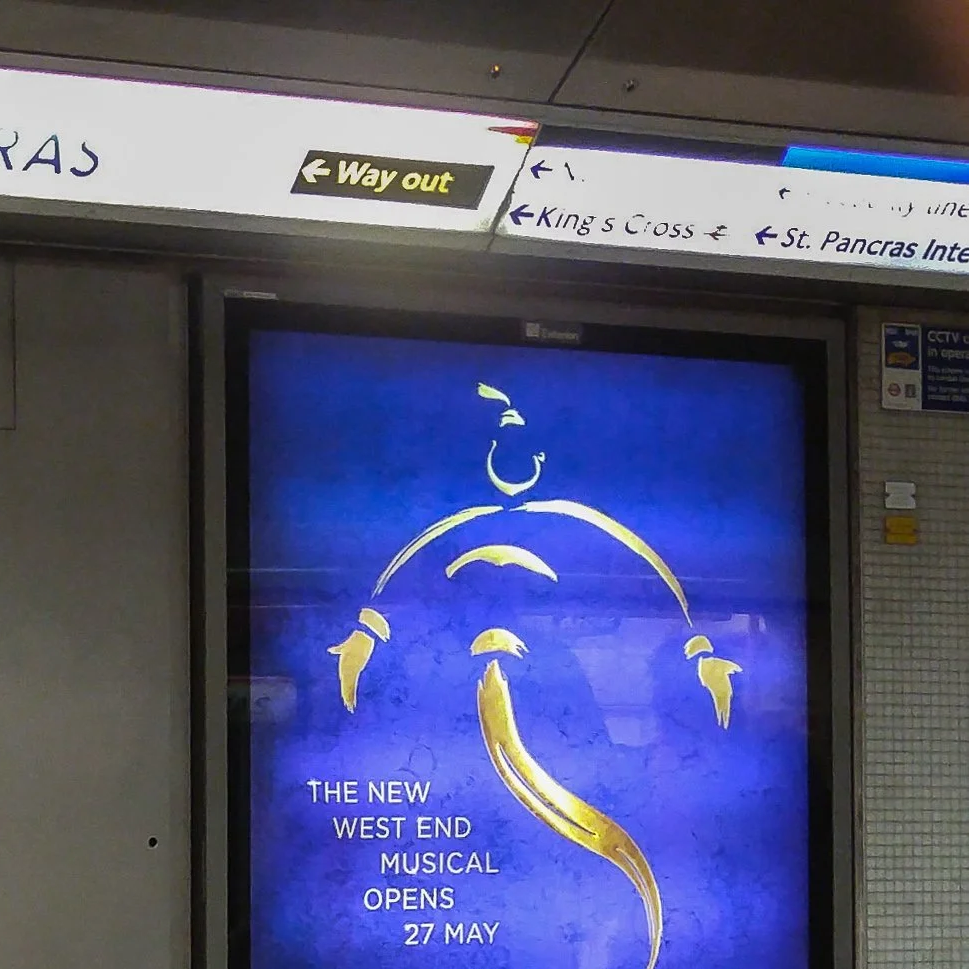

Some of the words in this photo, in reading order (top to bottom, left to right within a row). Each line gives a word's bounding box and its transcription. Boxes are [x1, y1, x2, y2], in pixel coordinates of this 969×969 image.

[337, 160, 397, 193] Way
[401, 171, 454, 193] out
[536, 206, 616, 236] Kings
[781, 227, 811, 249] St.
[820, 231, 919, 258] Pancras
[927, 330, 960, 343] CCTV
[307, 780, 358, 804] THE
[368, 781, 431, 803] NEW
[333, 817, 406, 838] WEST
[416, 817, 471, 838] END
[381, 852, 500, 874] MUSICAL
[363, 888, 455, 911] OPENS
[404, 923, 435, 945] 27
[444, 922, 500, 945] MAY
